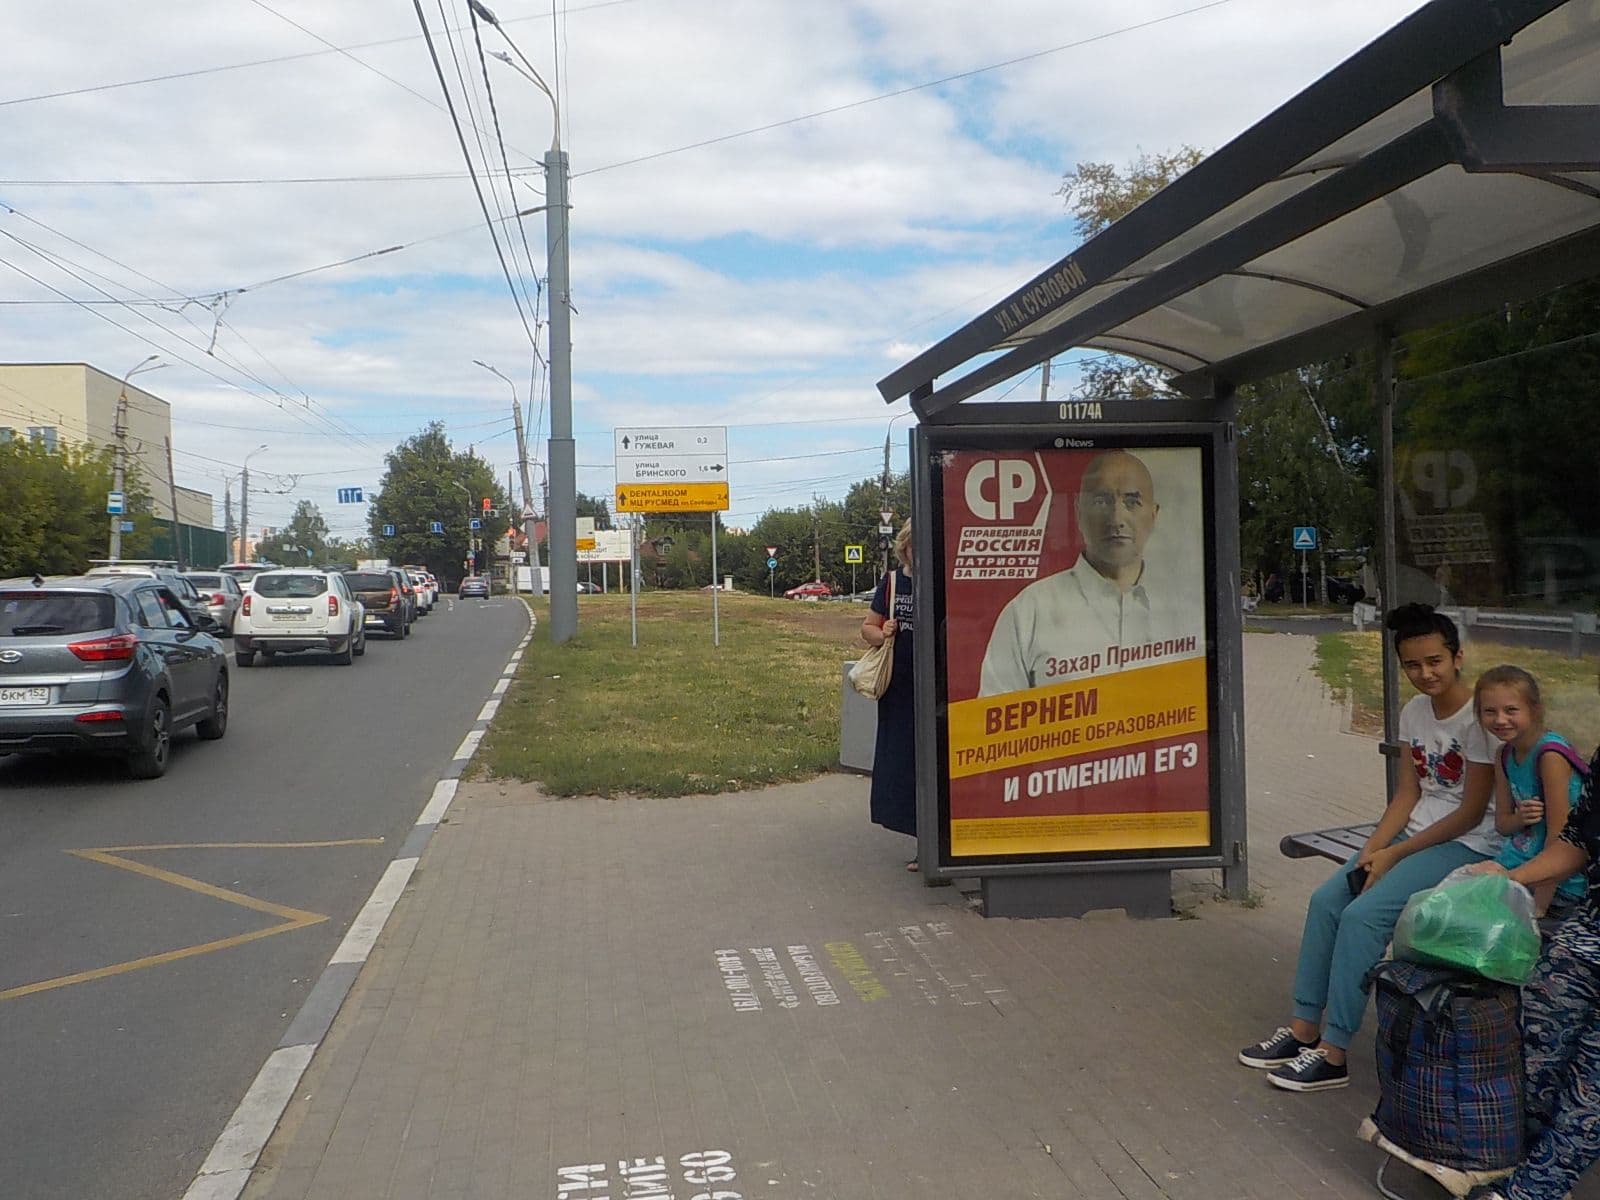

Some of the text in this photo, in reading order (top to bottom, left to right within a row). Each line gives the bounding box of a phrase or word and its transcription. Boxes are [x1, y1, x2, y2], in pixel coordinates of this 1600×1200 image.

[1022, 256, 1087, 315] СУСЛОВОЙ
[634, 434, 659, 442] улица
[635, 462, 660, 470] улица
[635, 470, 687, 478] БРИНСКОГО
[629, 489, 688, 498] DENTALROOM
[964, 459, 1037, 520] СР
[645, 499, 680, 507] РУСМЕД
[963, 528, 1043, 538] СПРАВЕДЛИВАЯ
[960, 539, 1041, 552] РОССИЯ
[955, 556, 1040, 566] ПАТРИОТЫ
[955, 568, 1035, 578] ЗА ПРАВДУ
[1045, 635, 1197, 678] Захар Прилепин
[985, 688, 1098, 735] ВЕРНЕМ
[956, 705, 1197, 767] ТРАДИЦИОННОЕ ОБРАЗОВАНИЕ
[1004, 742, 1198, 802] И ОТМЕНИМ ЕГЭ
